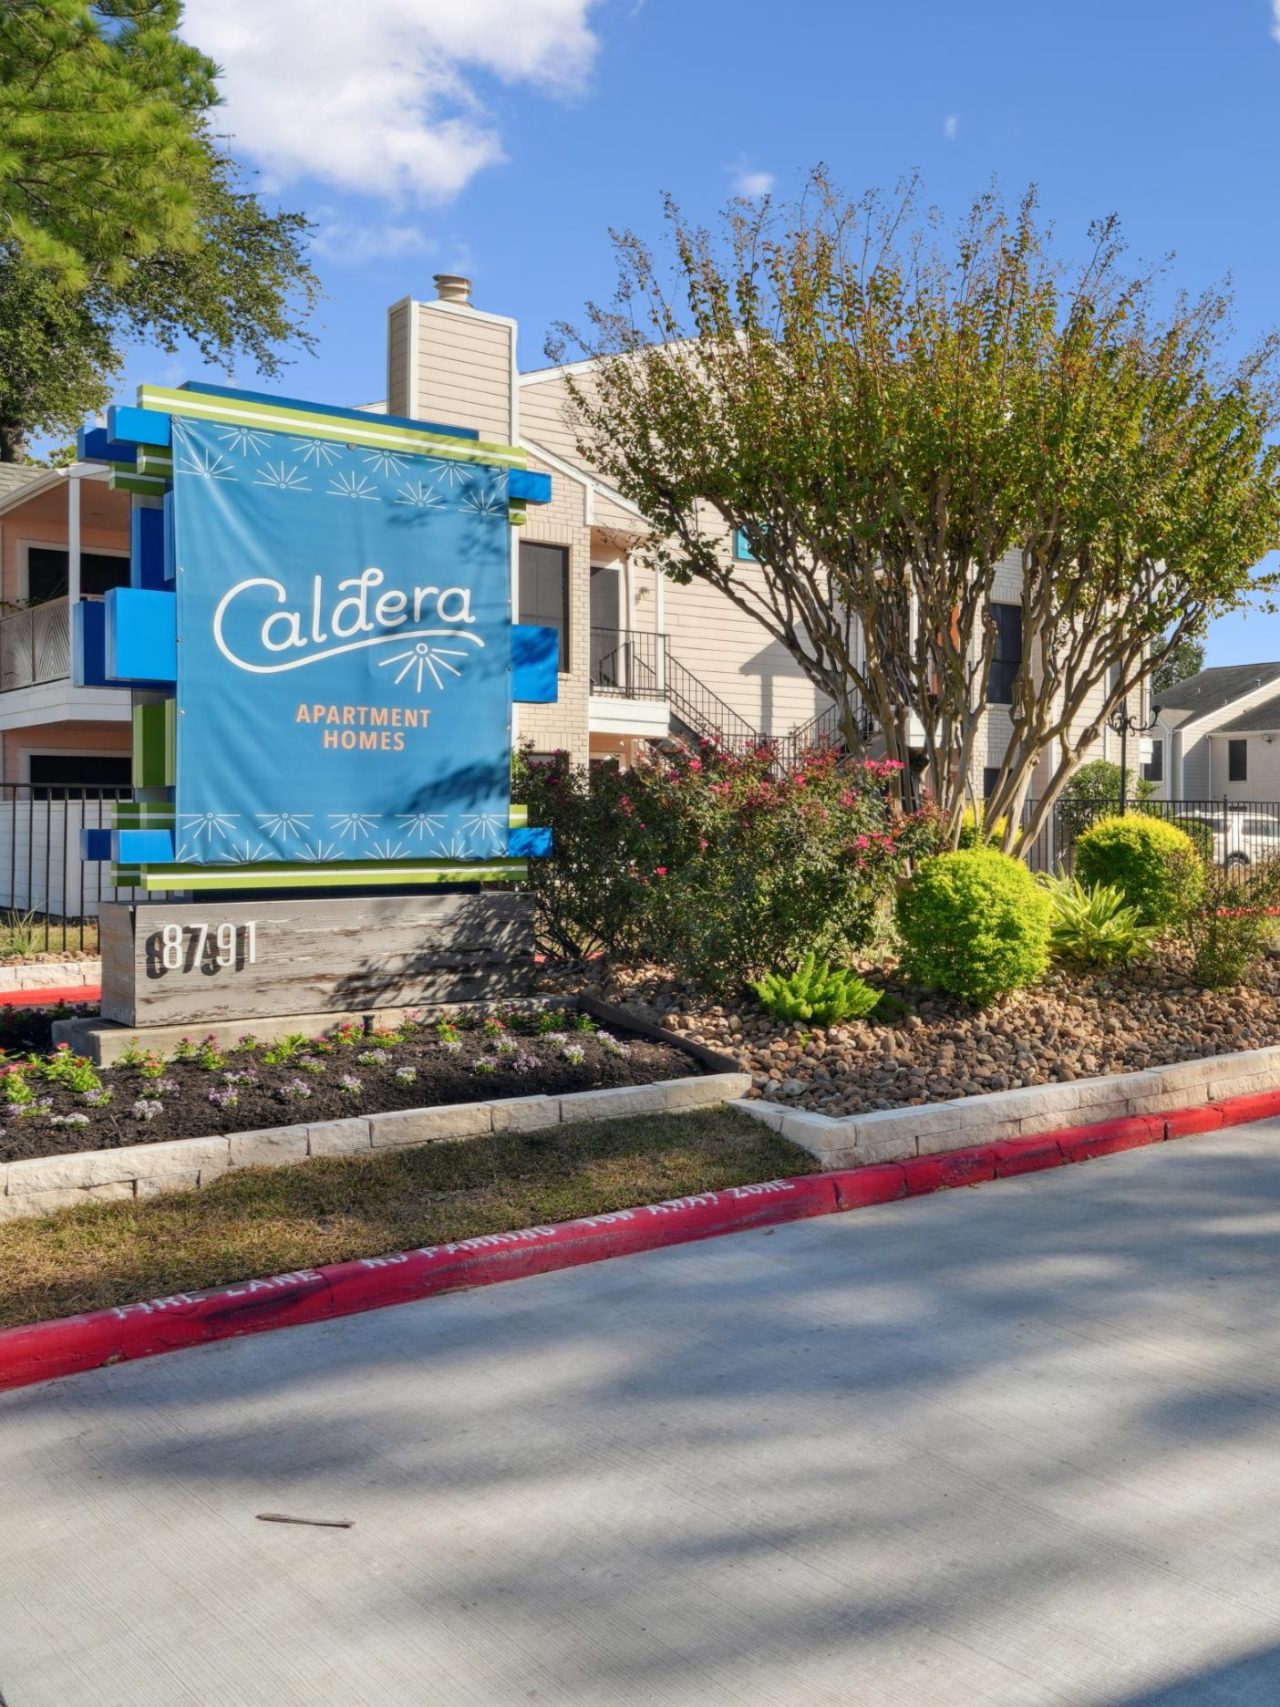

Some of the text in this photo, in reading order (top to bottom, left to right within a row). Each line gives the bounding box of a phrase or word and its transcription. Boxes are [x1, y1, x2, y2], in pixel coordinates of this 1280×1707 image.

[213, 567, 485, 673] Caldera
[296, 703, 431, 728] APARTMENT
[323, 730, 405, 751] HOMES
[163, 921, 256, 969] 8791
[724, 1179, 795, 1199] ZONE
